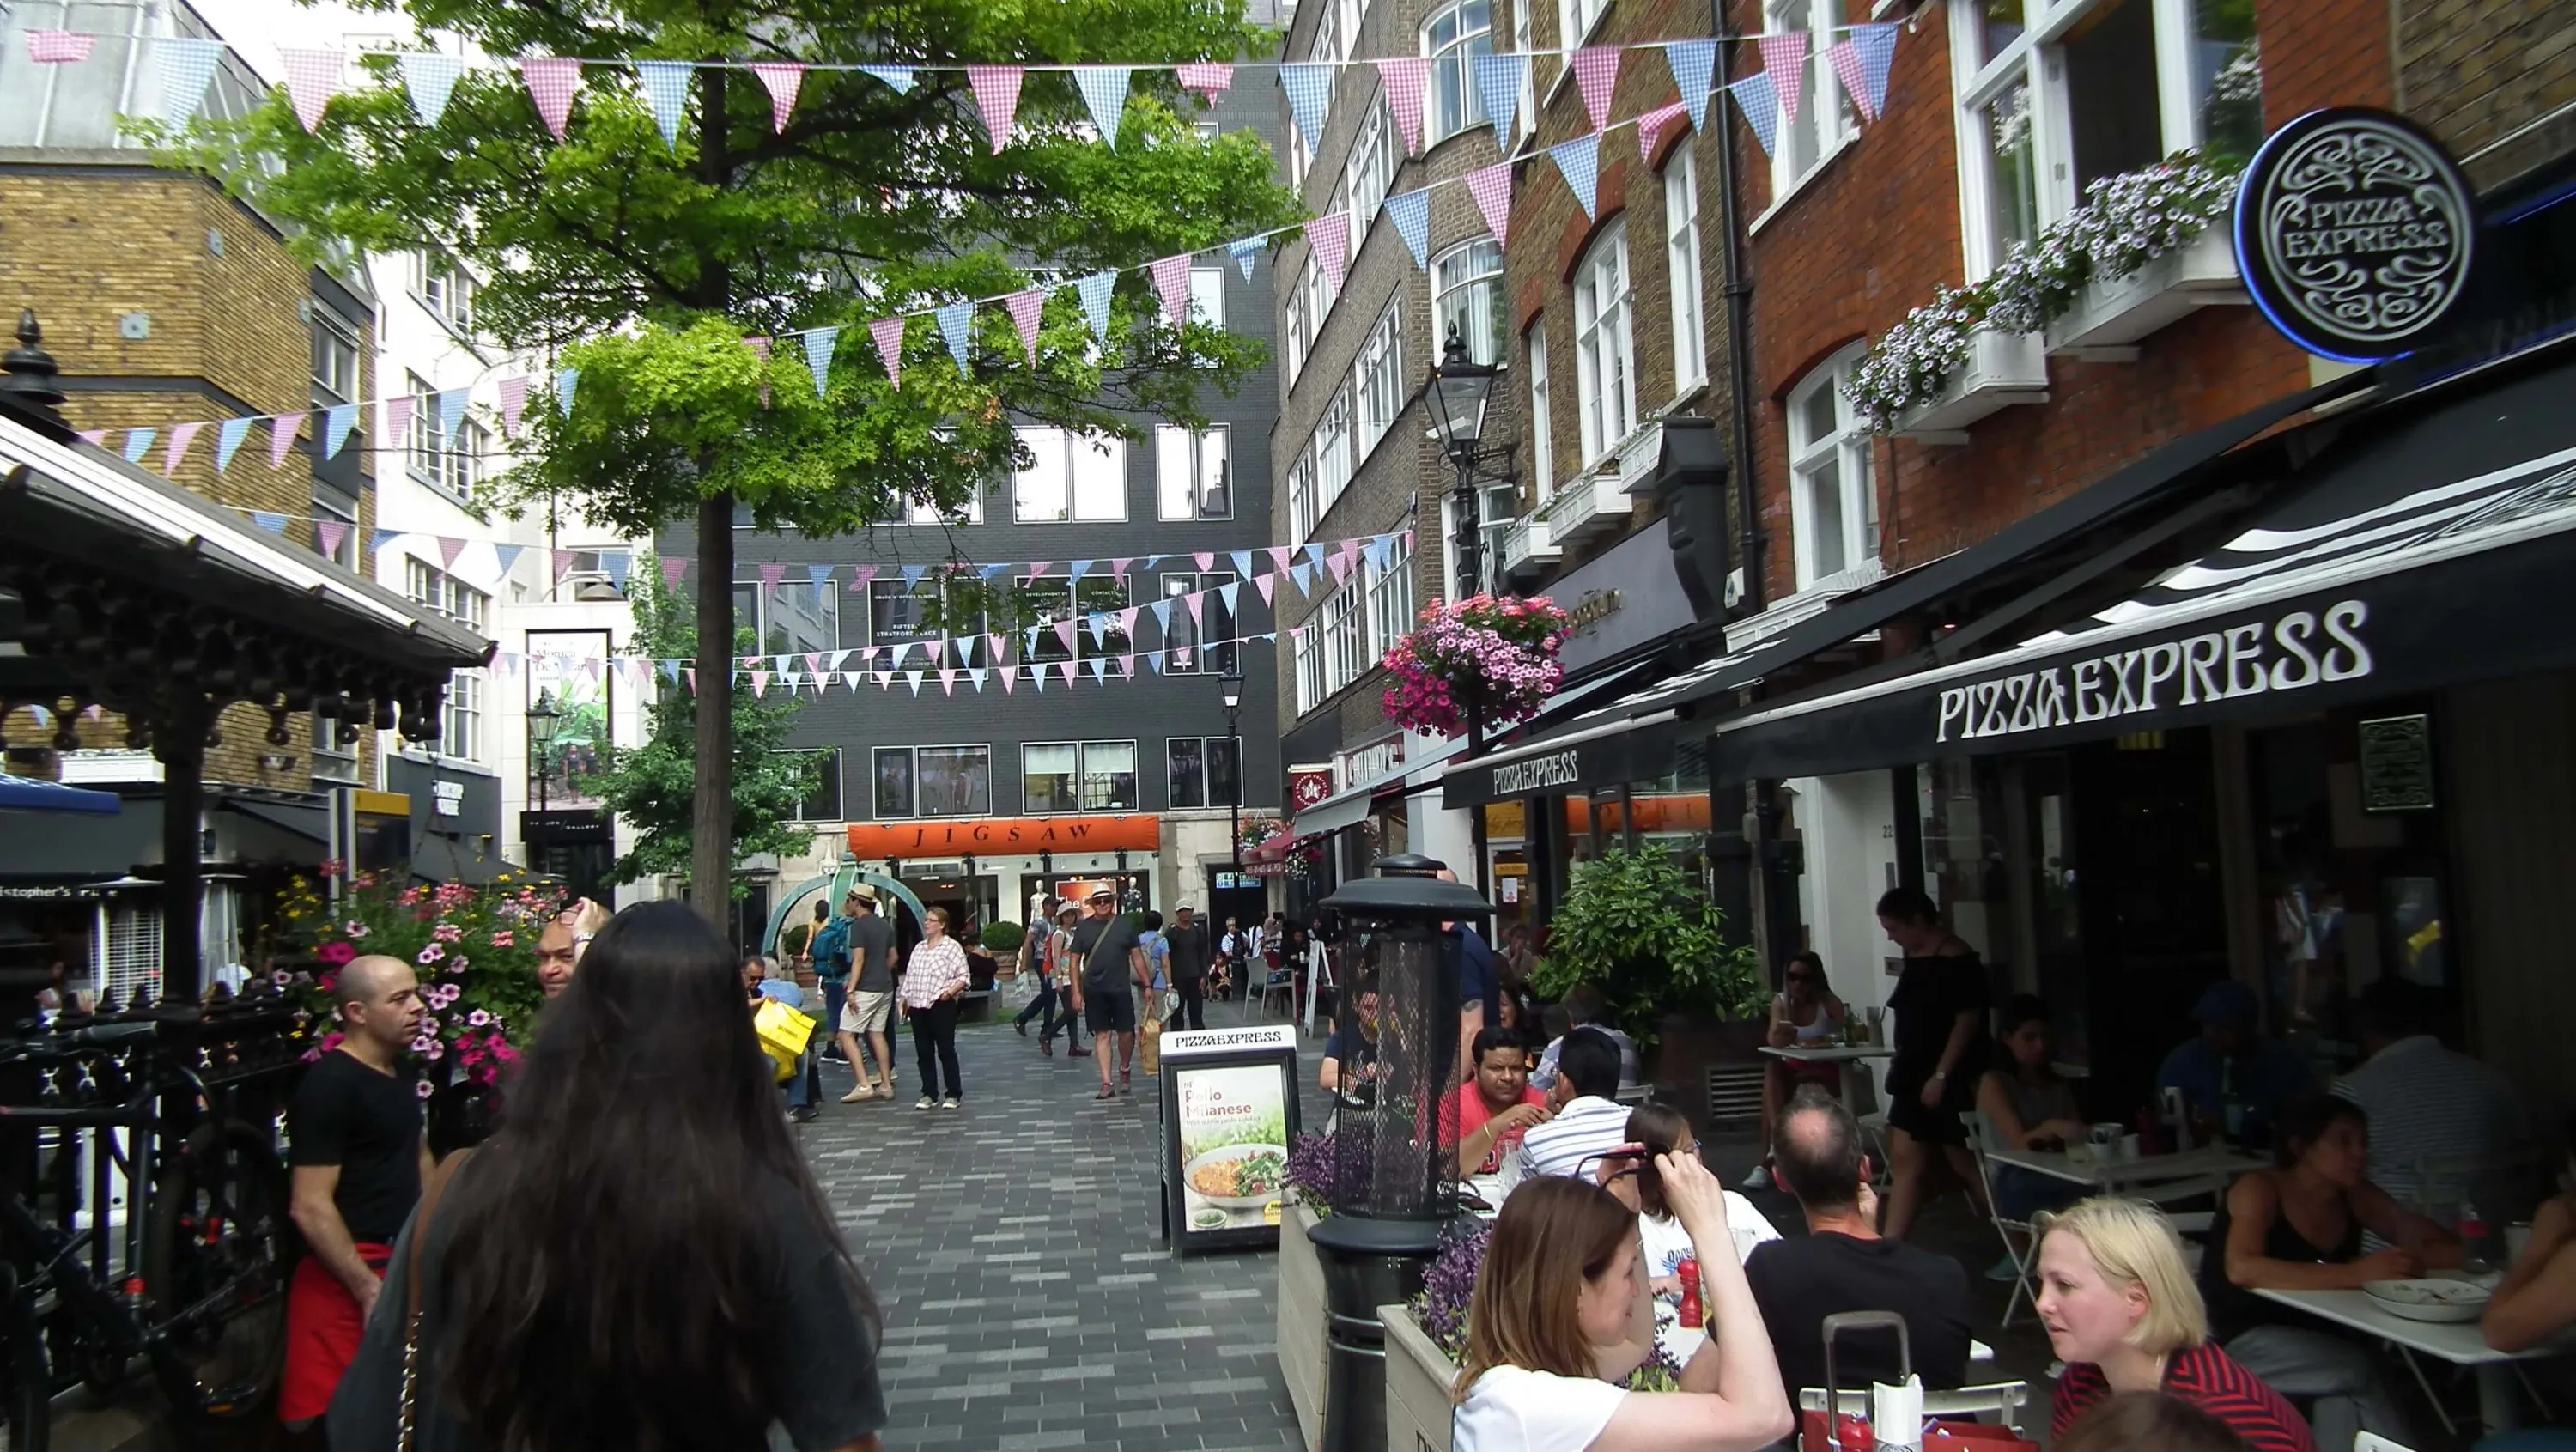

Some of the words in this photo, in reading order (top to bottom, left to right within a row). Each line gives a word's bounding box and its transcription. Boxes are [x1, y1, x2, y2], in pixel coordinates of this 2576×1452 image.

[2310, 196, 2416, 229] PIZZA
[2283, 220, 2449, 258] EXPRESS
[912, 824, 1091, 848] JIGSAW
